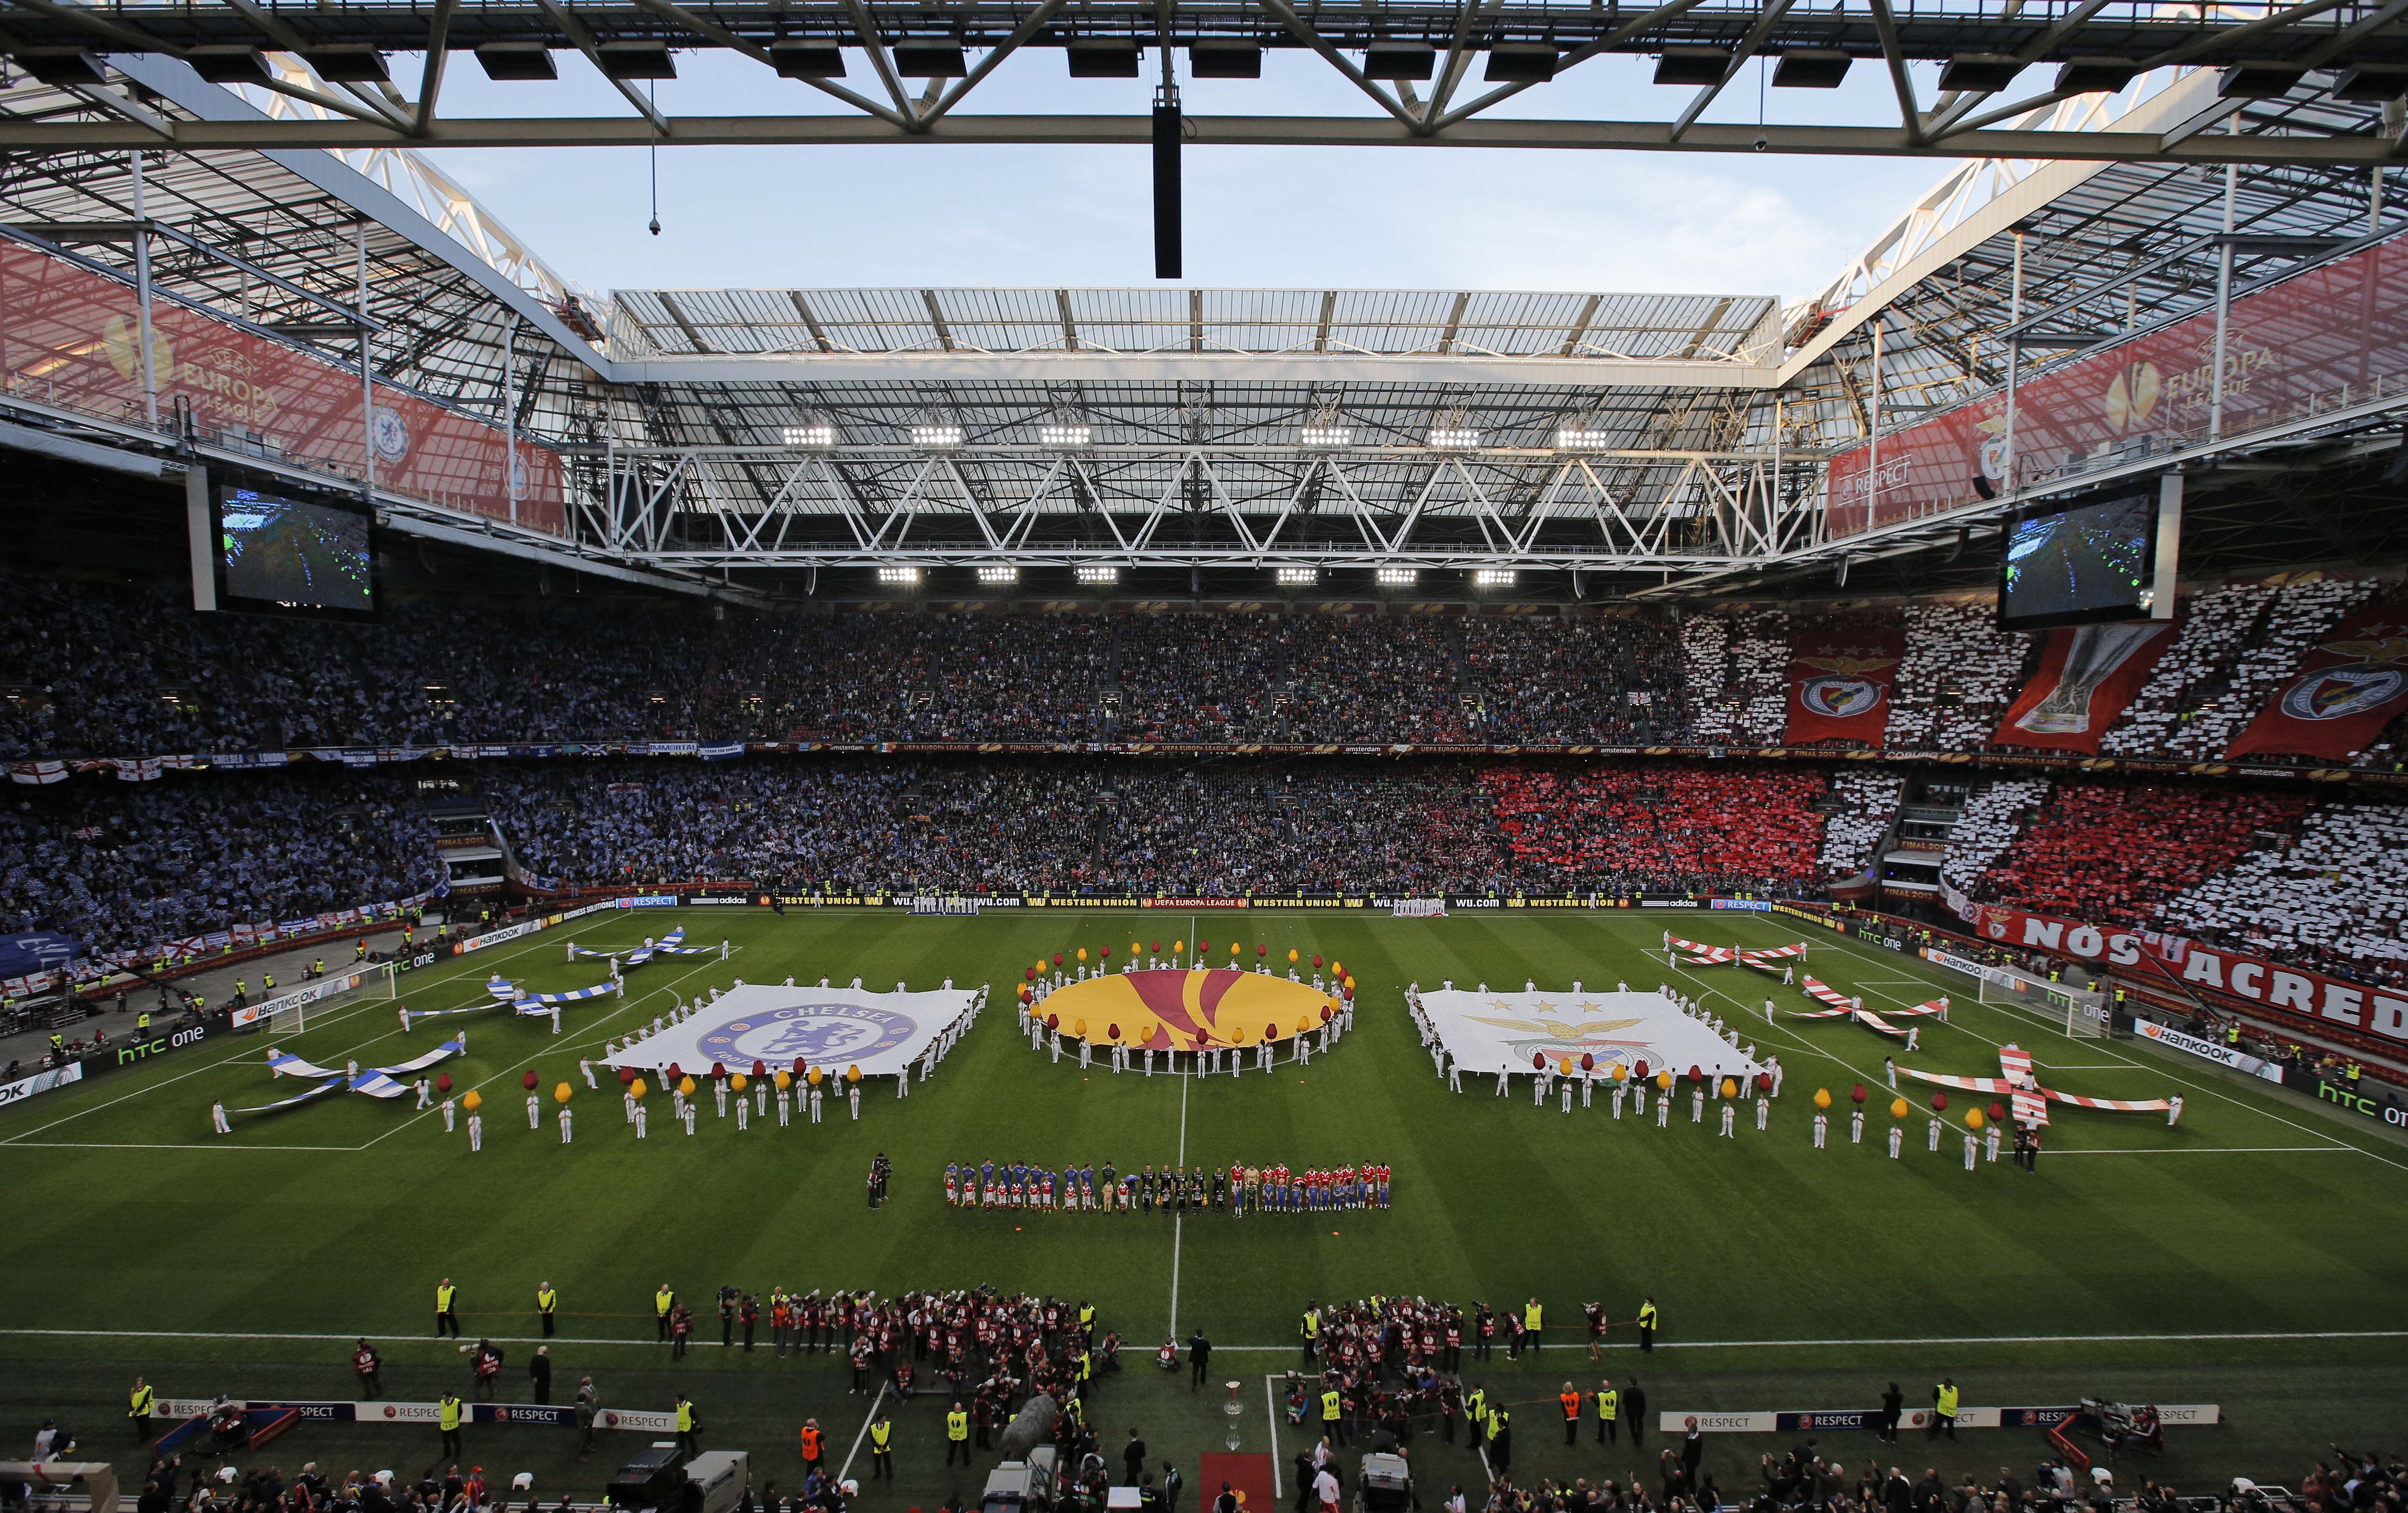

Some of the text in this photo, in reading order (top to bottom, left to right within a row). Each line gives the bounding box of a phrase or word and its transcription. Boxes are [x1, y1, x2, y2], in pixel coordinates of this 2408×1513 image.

[2197, 331, 2245, 359] UEFA
[210, 352, 252, 377] UEFA
[2168, 346, 2276, 398] EUROPA
[184, 362, 278, 410] EUROPA
[2186, 377, 2251, 409] LEAGUE
[206, 394, 262, 423] LEAGUE
[1855, 462, 1911, 495] RESPECT
[2239, 768, 2295, 777] amsterdam
[1902, 841, 1926, 849] FINAL
[452, 884, 501, 895] FINAL 2013
[1884, 887, 1910, 898] FINAL
[1911, 890, 1933, 900] 2013
[634, 897, 673, 906] RESPECT
[977, 897, 1020, 906] wu.com
[1727, 900, 1767, 911] RESPECT
[563, 906, 586, 920] BUSINESS
[586, 900, 615, 914] SOLUTIONS
[1772, 904, 1803, 918] WESTERN
[1803, 911, 1822, 924] UNION
[1858, 928, 1881, 945] htc
[2023, 917, 2141, 965] NÓS
[773, 1005, 896, 1024] CHELSEA
[118, 1038, 166, 1065] htc
[713, 1050, 855, 1066] FOOTBLL CLUB
[2319, 1080, 2377, 1117] htc
[174, 1405, 215, 1414] RESPEC
[300, 1407, 334, 1416] SPECT
[400, 1408, 441, 1417] RESPEC
[511, 1409, 558, 1421] RESPECT
[2158, 1410, 2197, 1420] ESPECT
[622, 1416, 668, 1427] RESPECT
[1702, 1418, 1750, 1427] RESPECT
[1815, 1415, 1863, 1426] RESPECT
